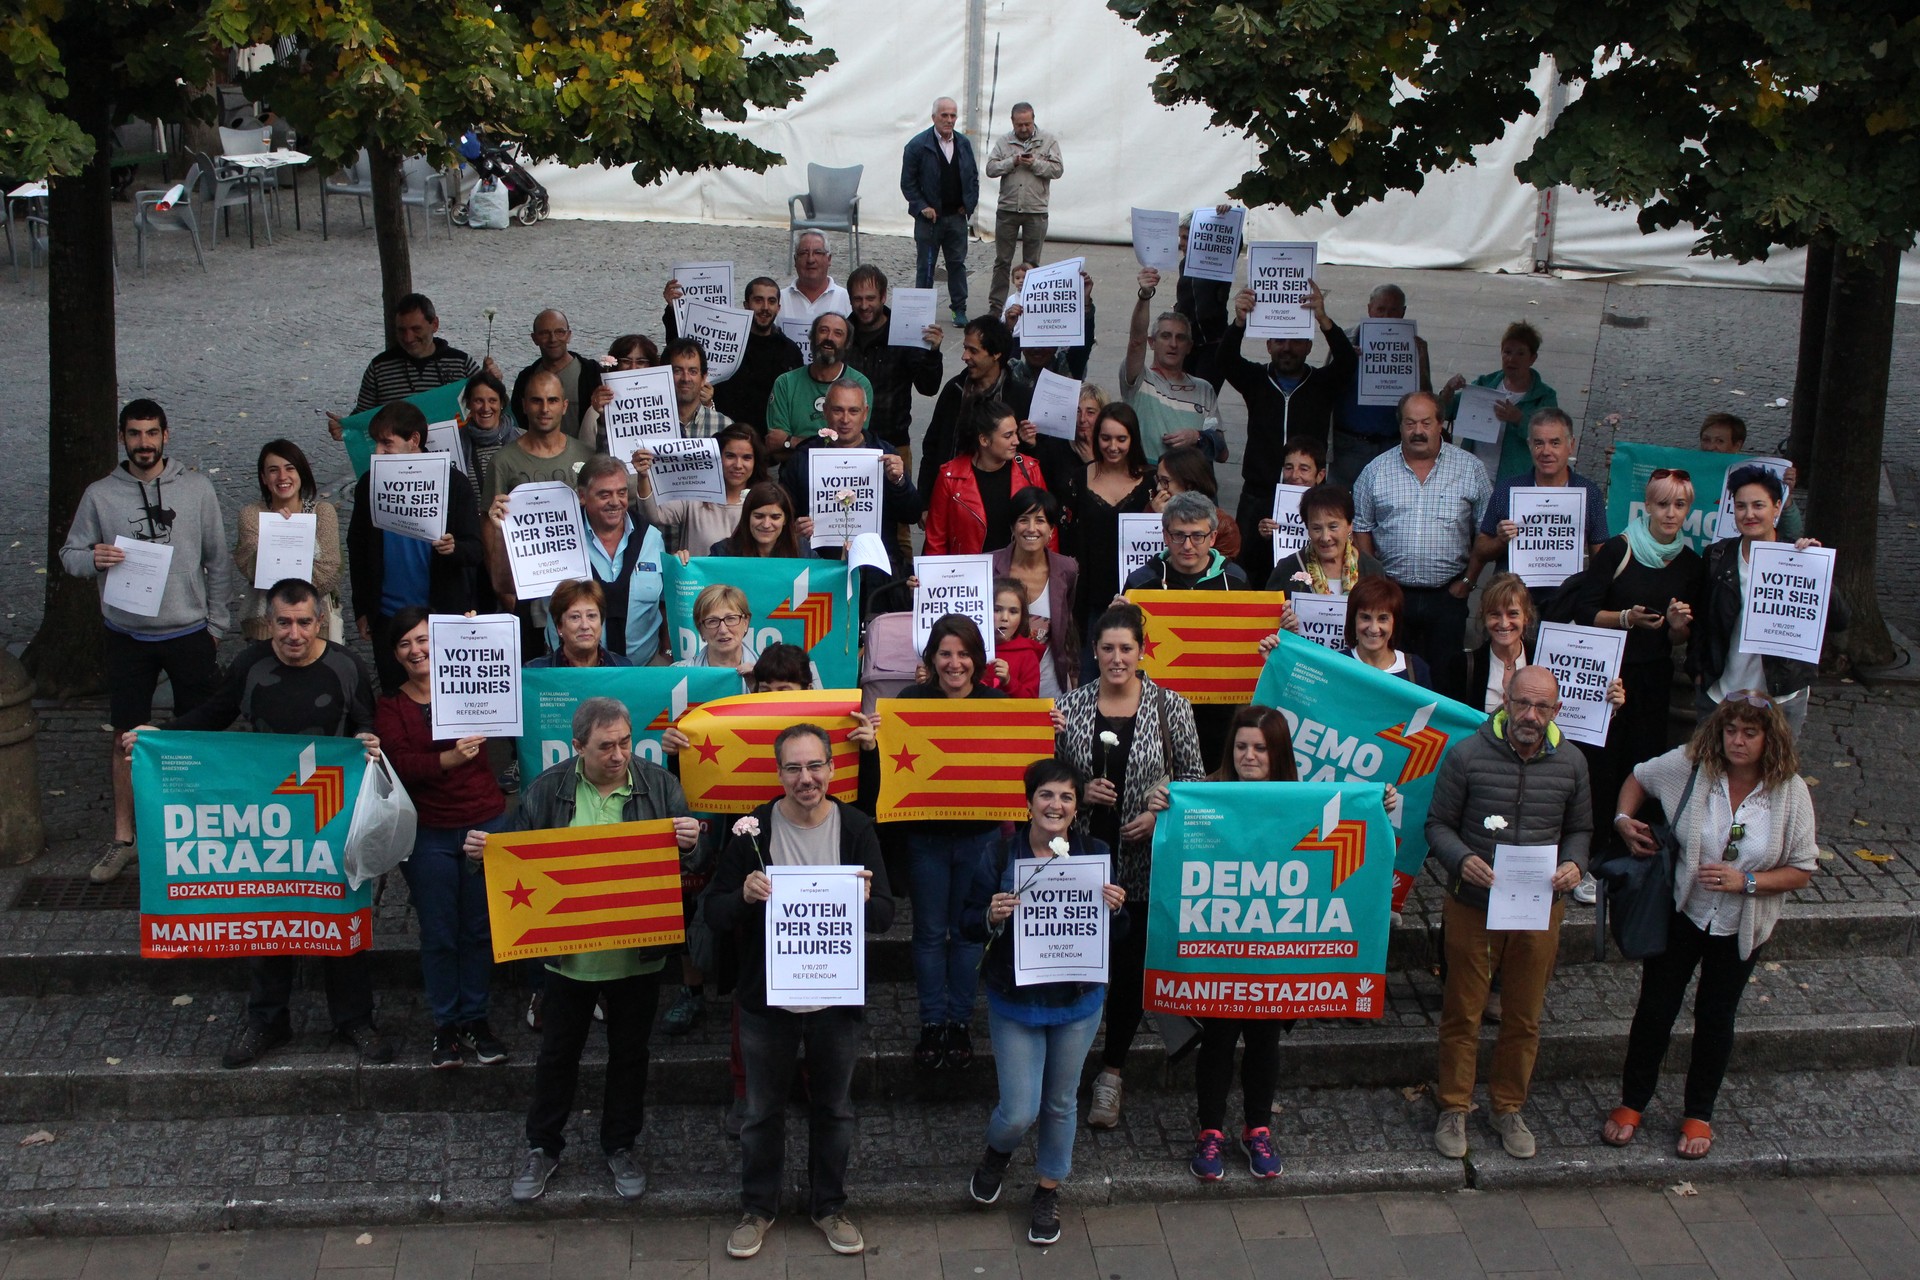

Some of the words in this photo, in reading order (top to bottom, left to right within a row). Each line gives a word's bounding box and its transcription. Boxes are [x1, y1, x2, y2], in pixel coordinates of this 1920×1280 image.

[1199, 222, 1233, 235] VOTEM
[1194, 232, 1213, 242] PER
[1215, 234, 1235, 245] SER
[1193, 241, 1233, 255] LLIURES
[1258, 267, 1304, 278] VOTEM
[681, 284, 723, 296] VOTEM
[1032, 279, 1072, 290] VOTEM
[1253, 280, 1279, 291] PER
[1282, 280, 1308, 291] SER
[1026, 291, 1049, 301] PER
[1053, 291, 1077, 301] SER
[1026, 303, 1076, 313] LLIURES
[693, 323, 737, 342] VOTEM
[713, 342, 739, 353] SER
[1369, 341, 1409, 351] VOTEM
[1365, 353, 1387, 363] PER
[1391, 353, 1413, 363] SER
[1365, 365, 1413, 375] LLIURES
[615, 395, 664, 411] VOTEM
[612, 411, 639, 425] PER
[643, 408, 670, 421] SER
[615, 421, 671, 438] LLIURES
[652, 439, 704, 456] VOTEM
[652, 455, 680, 465] PER
[683, 449, 712, 462] SER
[655, 461, 714, 475] LLIURES
[383, 480, 435, 492] VOTEM
[821, 476, 870, 488] VOTEM
[378, 493, 406, 504] PER
[411, 493, 439, 505] SER
[816, 490, 840, 501] PE
[379, 504, 438, 518] LLIURES
[513, 510, 568, 526] VOTEM
[1522, 514, 1572, 525] VOTEM
[511, 528, 541, 543] PER
[545, 524, 576, 538] SER
[1278, 526, 1304, 536] PER
[1516, 527, 1543, 537] PER
[1547, 527, 1575, 537] SER
[515, 538, 577, 558] LLIURES
[1517, 539, 1575, 551] LLIURES
[1762, 572, 1817, 590] VOTEM
[928, 586, 978, 598] VOTEM
[1753, 587, 1784, 601] PER
[1788, 590, 1820, 606] SER
[921, 601, 950, 614] PER
[954, 600, 984, 613] SER
[1753, 602, 1817, 621] LLIURES
[1303, 621, 1344, 636] VOTE
[444, 648, 504, 662] VOTEM
[1549, 652, 1606, 673] VOTEM
[439, 665, 471, 678] PER
[477, 664, 511, 678] SER
[440, 680, 511, 694] LLIURES
[1575, 672, 1608, 688] SER
[163, 803, 291, 839] DEMO
[166, 839, 338, 876] KRAZIA
[1181, 859, 1309, 897] DEMO
[169, 884, 235, 897] BOZKATU
[238, 882, 341, 897] ERABAKITZEKO
[1030, 889, 1093, 903] VOTEM
[782, 903, 846, 918] VOTEM
[1023, 906, 1058, 919] PER
[1063, 906, 1098, 919] SER
[1178, 897, 1353, 934] KRAZIA
[151, 919, 342, 941] MANIFESTAZIOA
[776, 921, 811, 936] PER
[816, 921, 853, 936] SER
[1024, 922, 1097, 937] LLIURES
[152, 944, 189, 953] IRAILAK
[192, 945, 203, 953] 16
[215, 943, 240, 952] 17:30
[251, 941, 279, 950] BILBO
[289, 941, 301, 949] LA
[304, 941, 342, 950] CASILLA
[777, 940, 852, 955] LLIURES
[1179, 943, 1244, 955] BOZKATU
[1248, 943, 1354, 956] ERABAKITZEKO
[1155, 977, 1349, 1002] MANIFESTAZIOA
[1154, 1000, 1192, 1011] IRAILAK
[1196, 1003, 1207, 1011] 16
[1255, 1005, 1282, 1013] BILBO
[1293, 1005, 1305, 1013] LA
[1308, 1003, 1348, 1012] CASILLA
